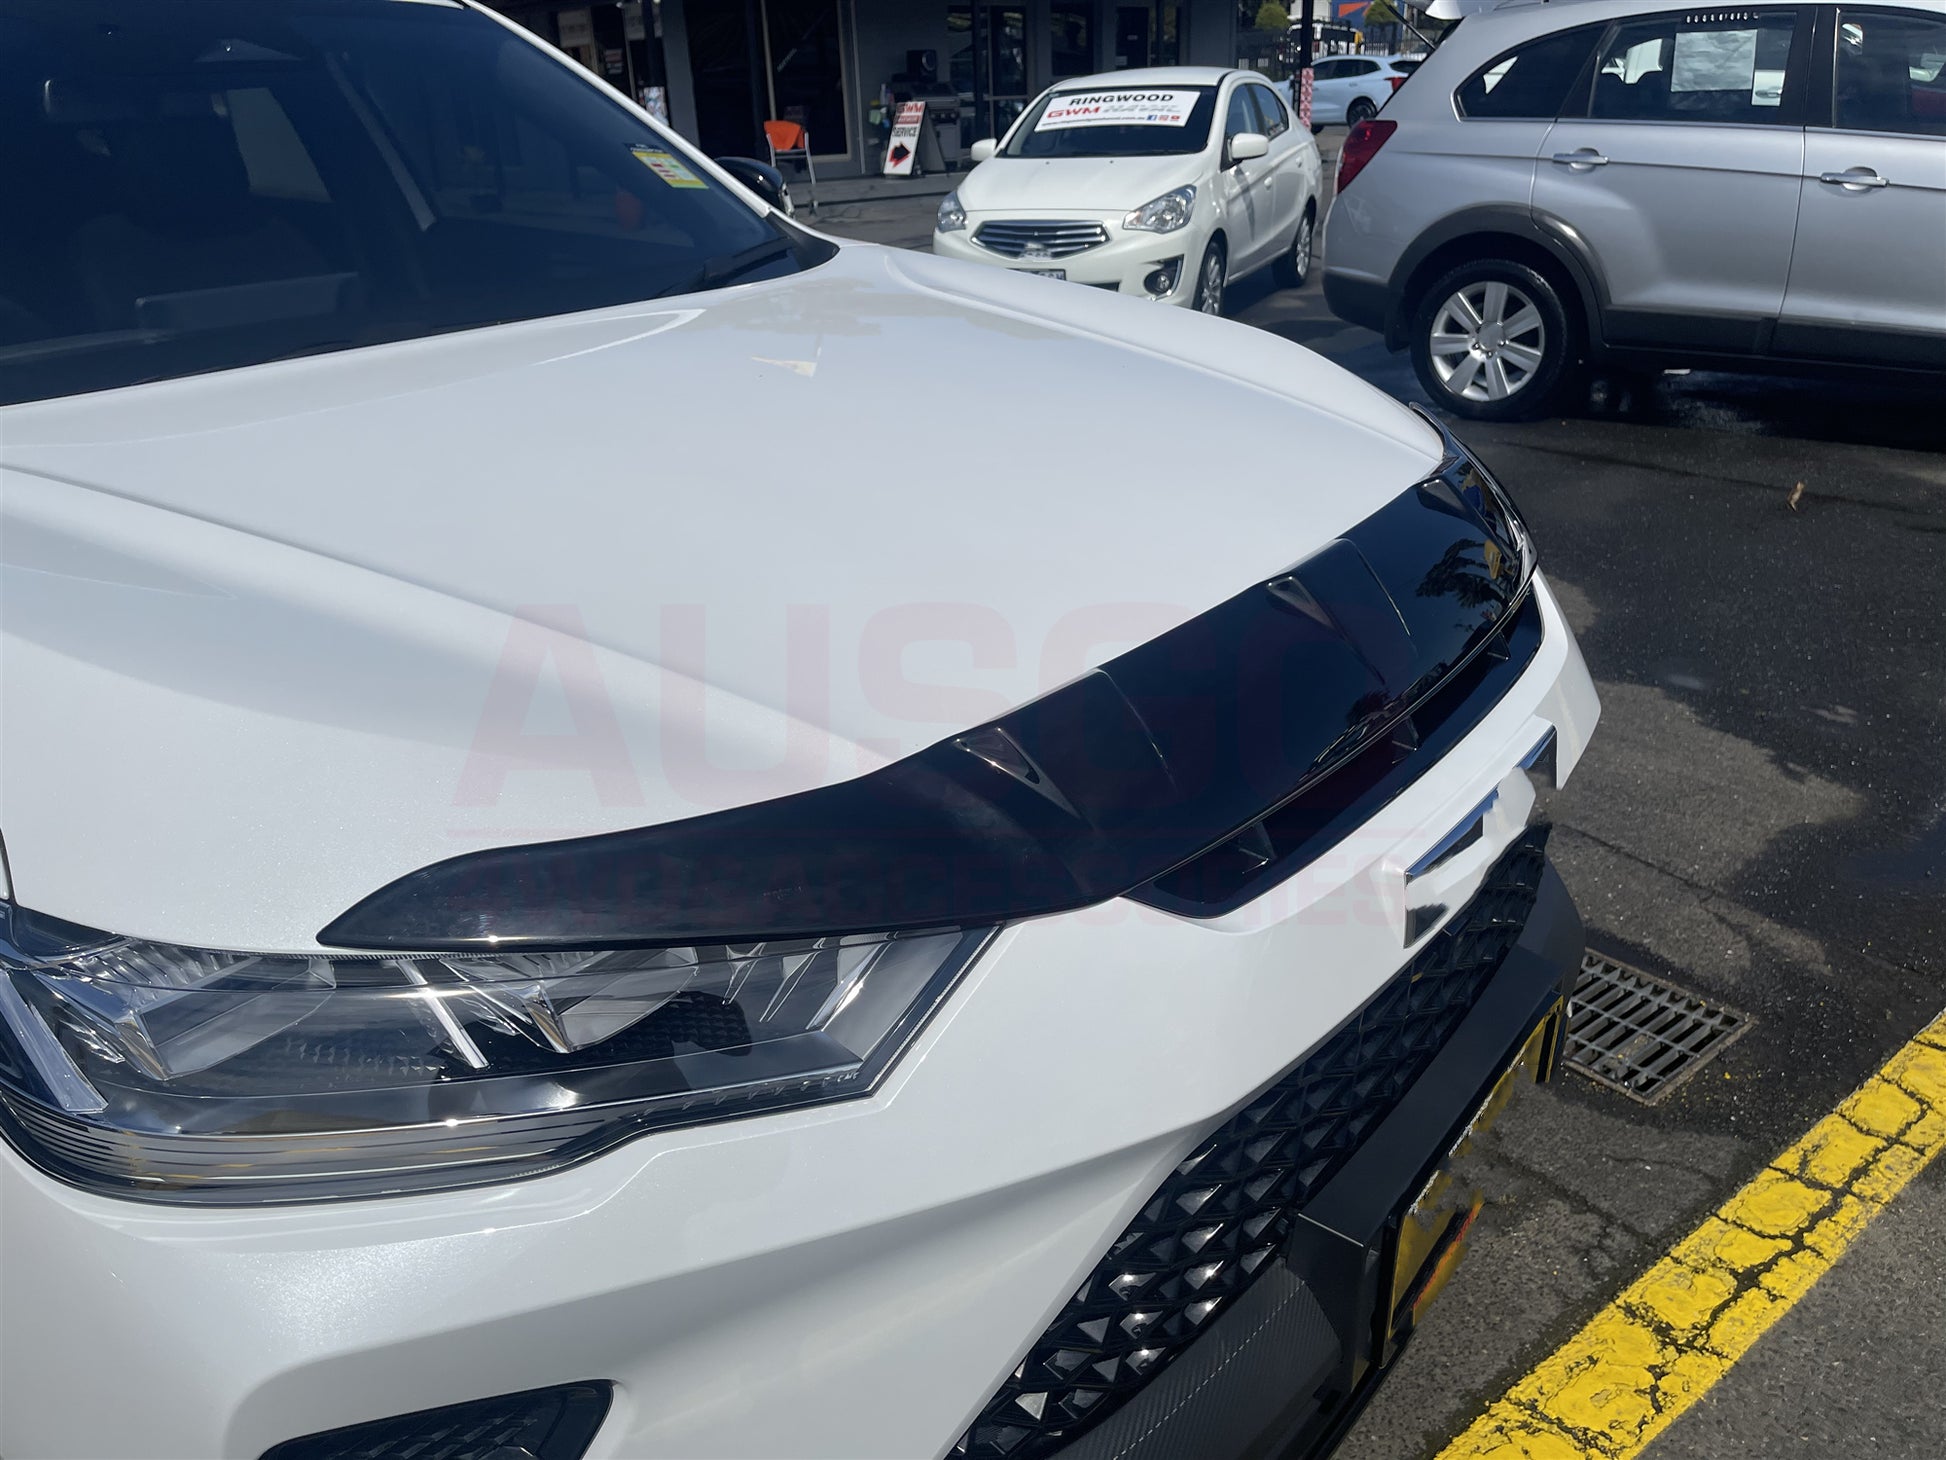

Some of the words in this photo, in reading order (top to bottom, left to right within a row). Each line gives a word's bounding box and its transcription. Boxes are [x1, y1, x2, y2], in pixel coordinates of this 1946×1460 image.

[1069, 93, 1174, 106] RINGWOOD
[1047, 105, 1101, 119] GWM
[892, 126, 917, 138] SERVICE
